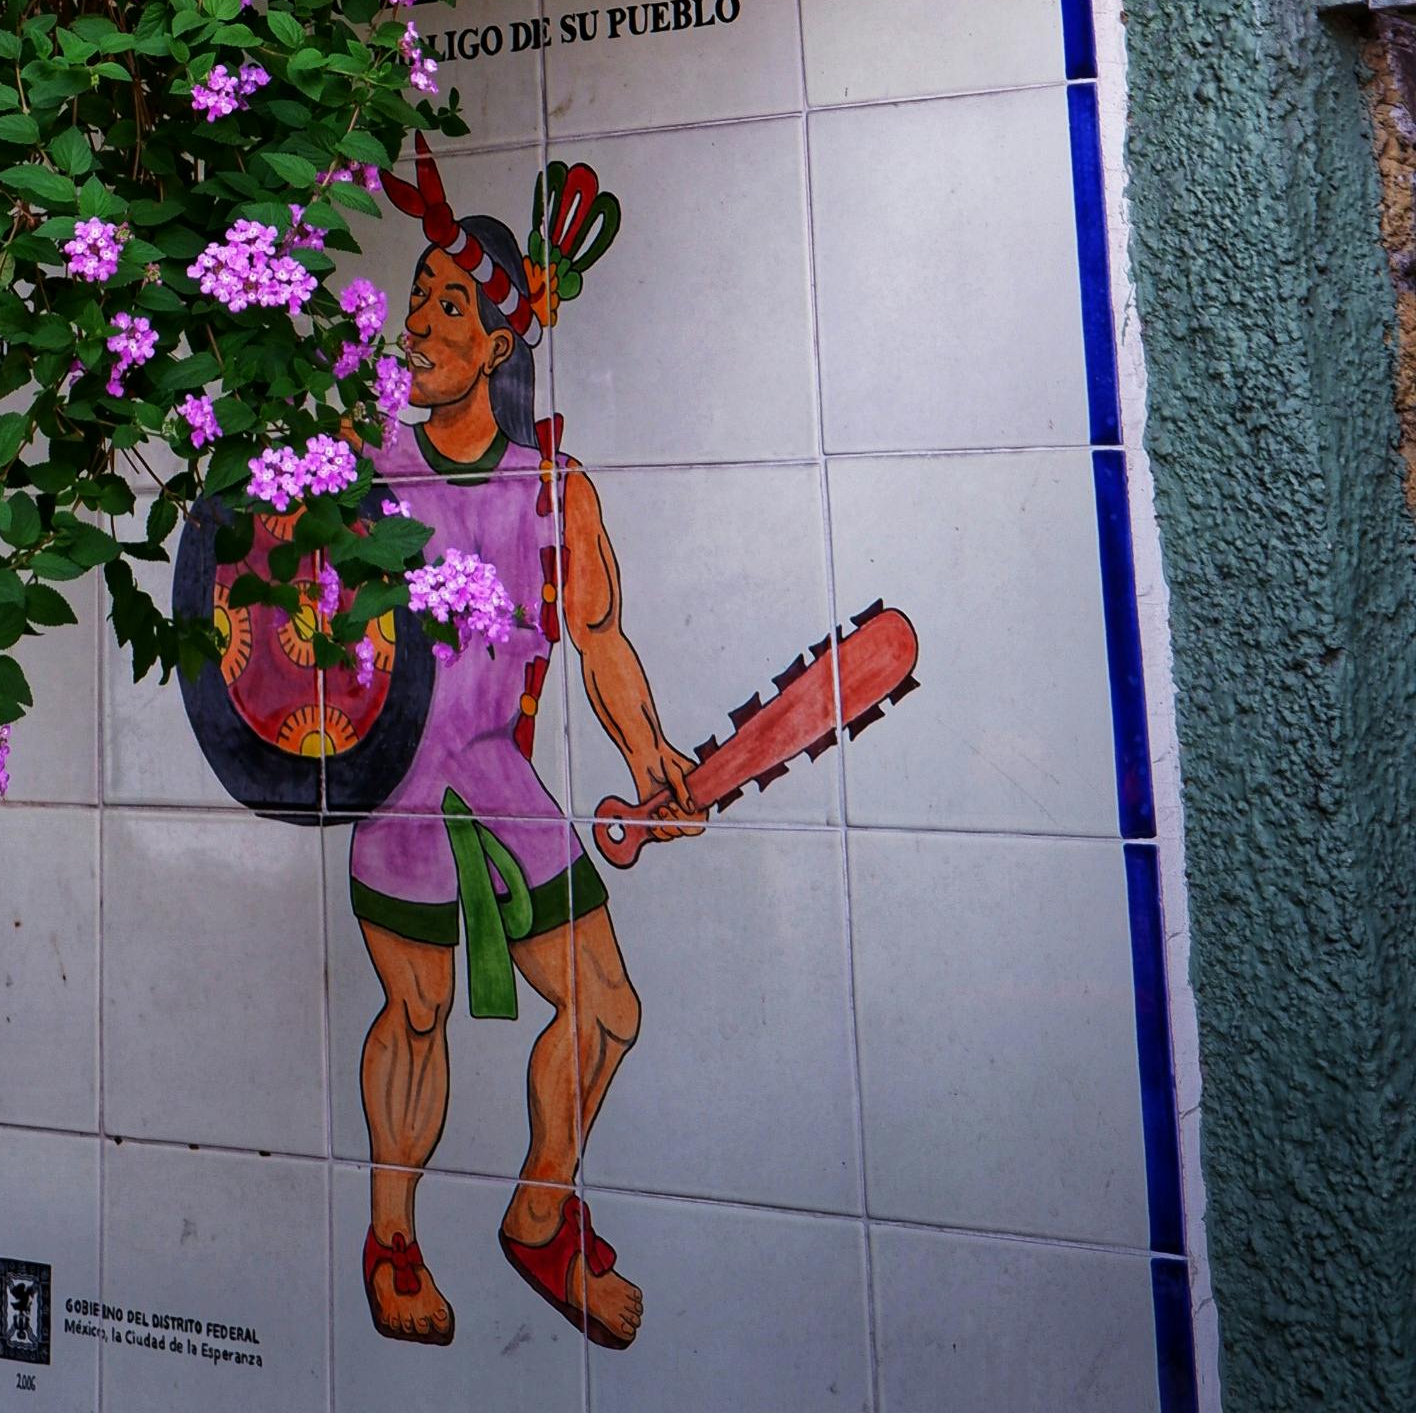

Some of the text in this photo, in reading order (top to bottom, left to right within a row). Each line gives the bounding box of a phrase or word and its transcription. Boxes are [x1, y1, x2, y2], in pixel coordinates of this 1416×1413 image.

[510, 16, 552, 52] DE
[560, 10, 600, 44] SU
[127, 1310, 149, 1327] DEL
[152, 1314, 202, 1334] DISTRITO
[207, 1323, 260, 1344] FEDERAL
[112, 1328, 122, 1343] la
[125, 1330, 165, 1349] Ciudad
[169, 1337, 183, 1353] de
[187, 1340, 197, 1356] la
[202, 1344, 262, 1367] Esperanza
[16, 1373, 36, 1391] 2006
